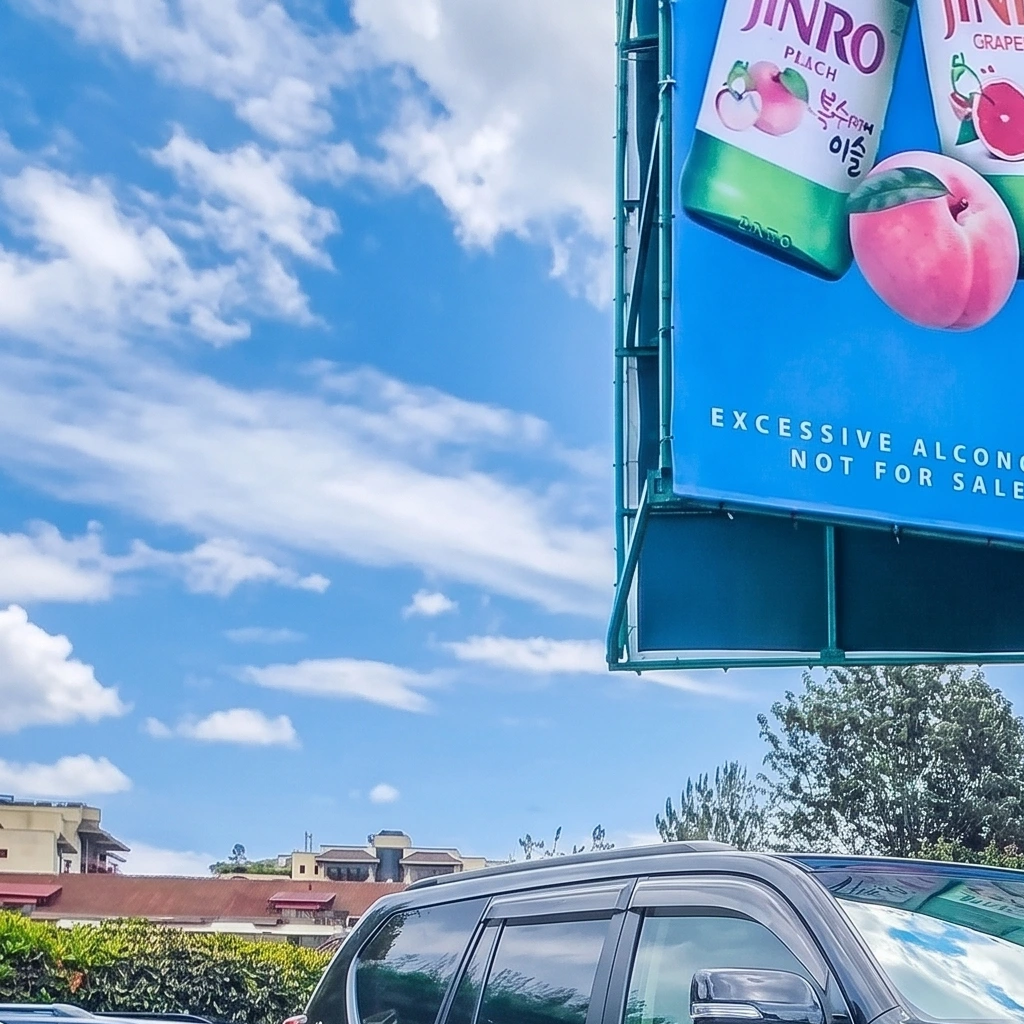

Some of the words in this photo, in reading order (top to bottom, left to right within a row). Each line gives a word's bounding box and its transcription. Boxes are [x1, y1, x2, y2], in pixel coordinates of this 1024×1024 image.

[829, 135, 866, 177] 이슬
[711, 407, 891, 452] EXCESSIVE
[791, 449, 854, 475] NOT
[875, 461, 932, 487] FOR
[953, 472, 1024, 500] SALE
